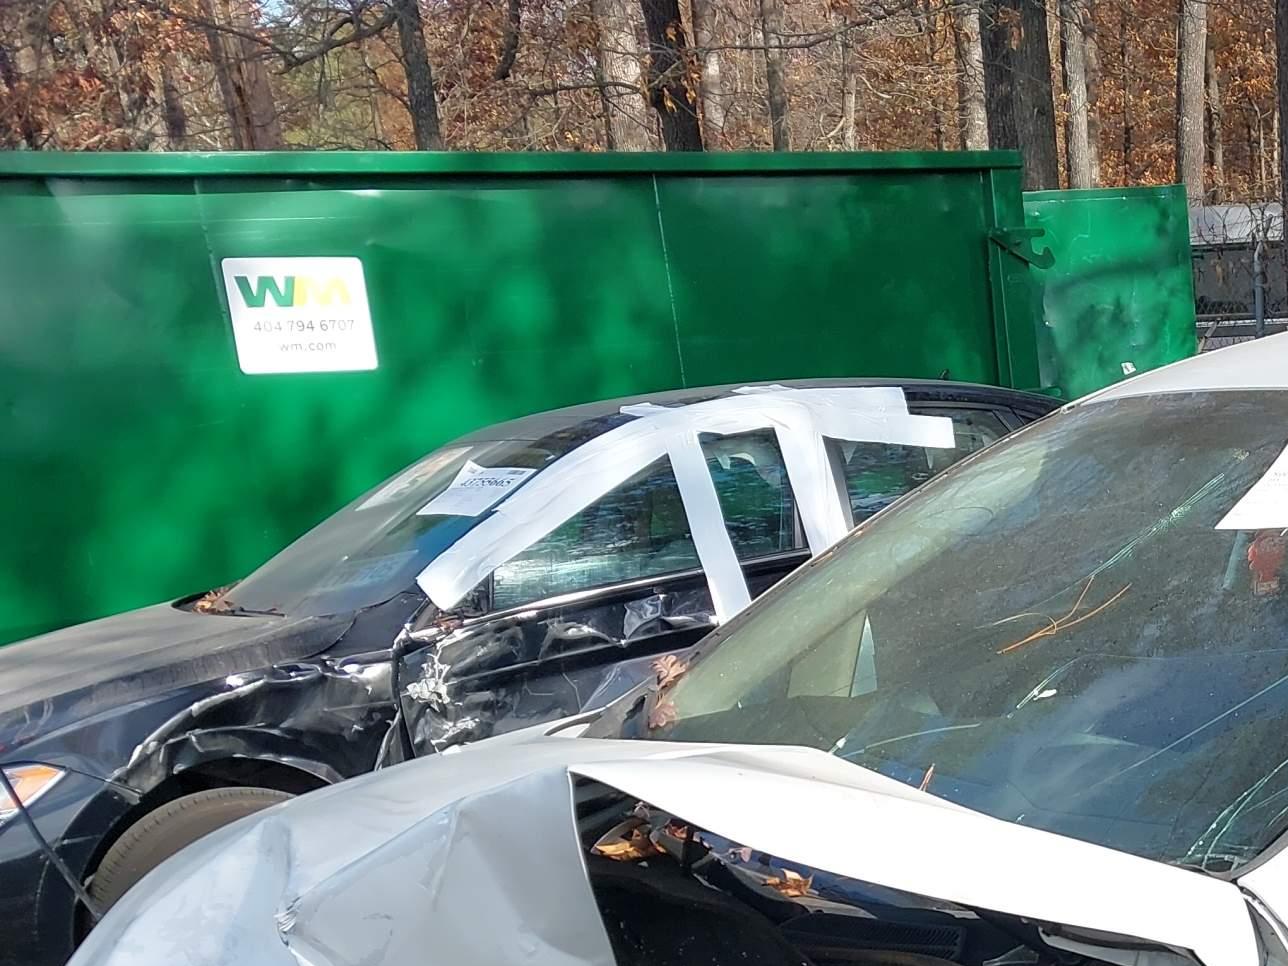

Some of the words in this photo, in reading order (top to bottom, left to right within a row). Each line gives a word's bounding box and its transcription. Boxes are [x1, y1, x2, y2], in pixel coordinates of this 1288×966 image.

[234, 275, 352, 308] WM
[253, 321, 283, 332] 404
[287, 320, 315, 332] 794
[319, 319, 355, 332] 6707
[279, 341, 337, 352] wm.com
